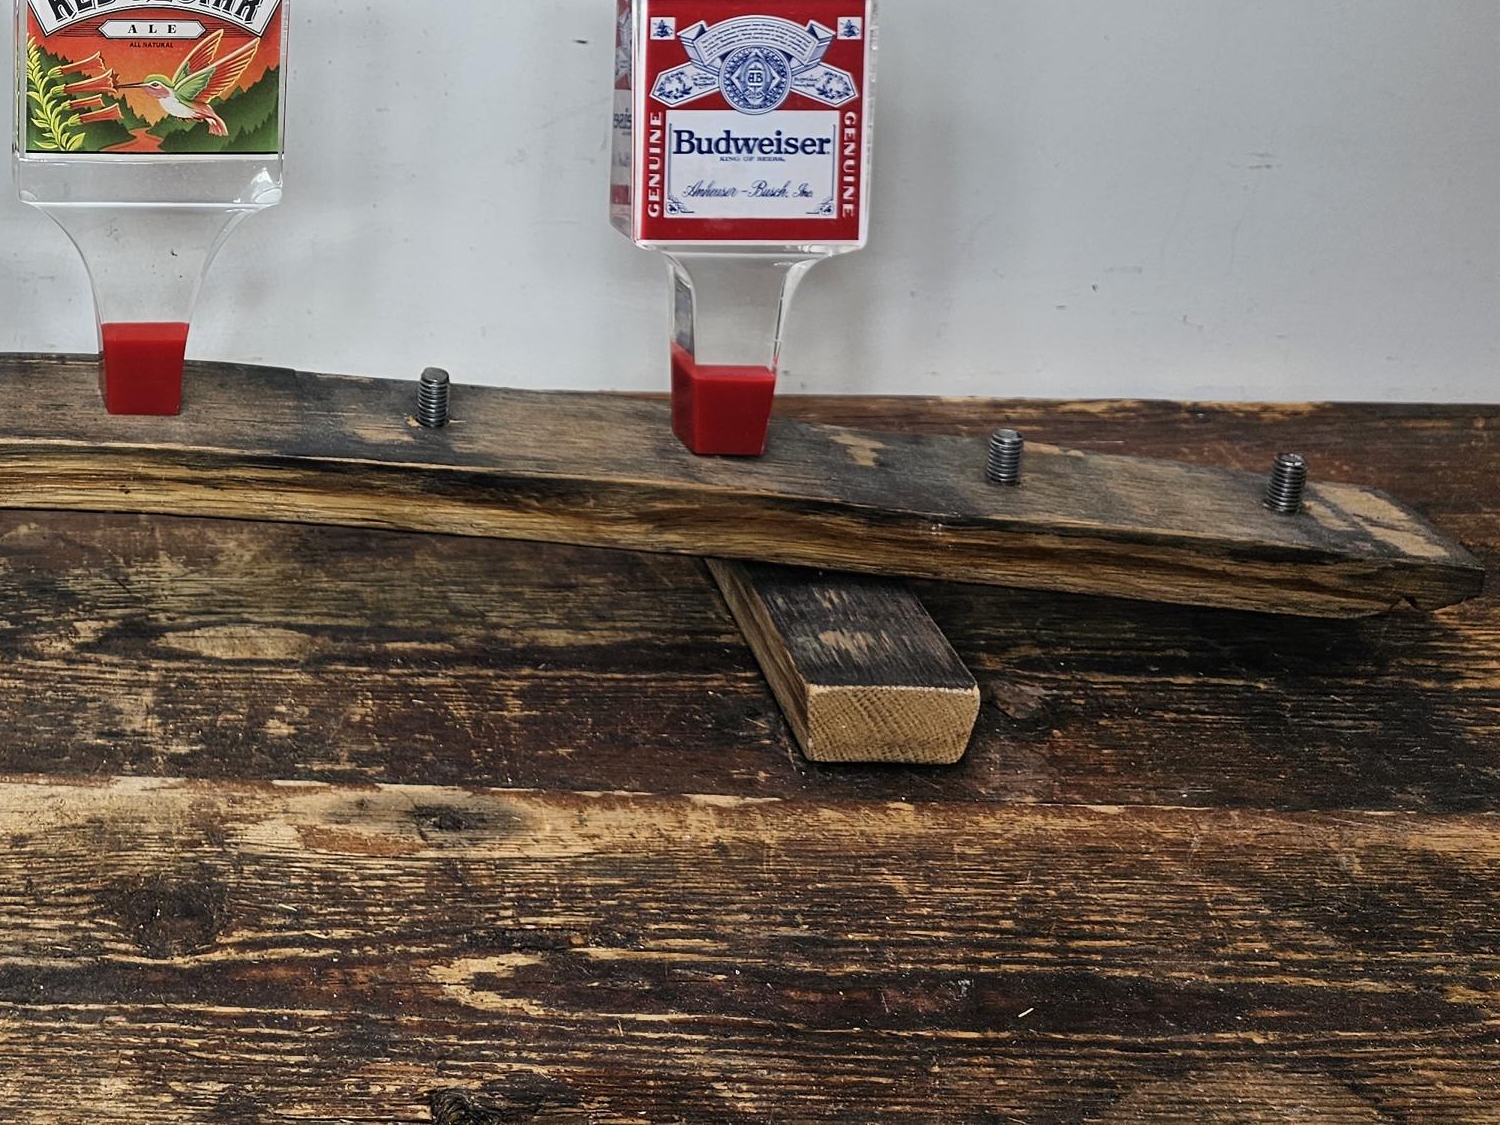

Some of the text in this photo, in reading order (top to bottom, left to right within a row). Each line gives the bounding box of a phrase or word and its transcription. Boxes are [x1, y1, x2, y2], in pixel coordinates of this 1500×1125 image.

[127, 24, 177, 34] ALE
[647, 111, 662, 218] GENUINE
[672, 129, 832, 155] Budweiser
[842, 111, 857, 218] GENUINE
